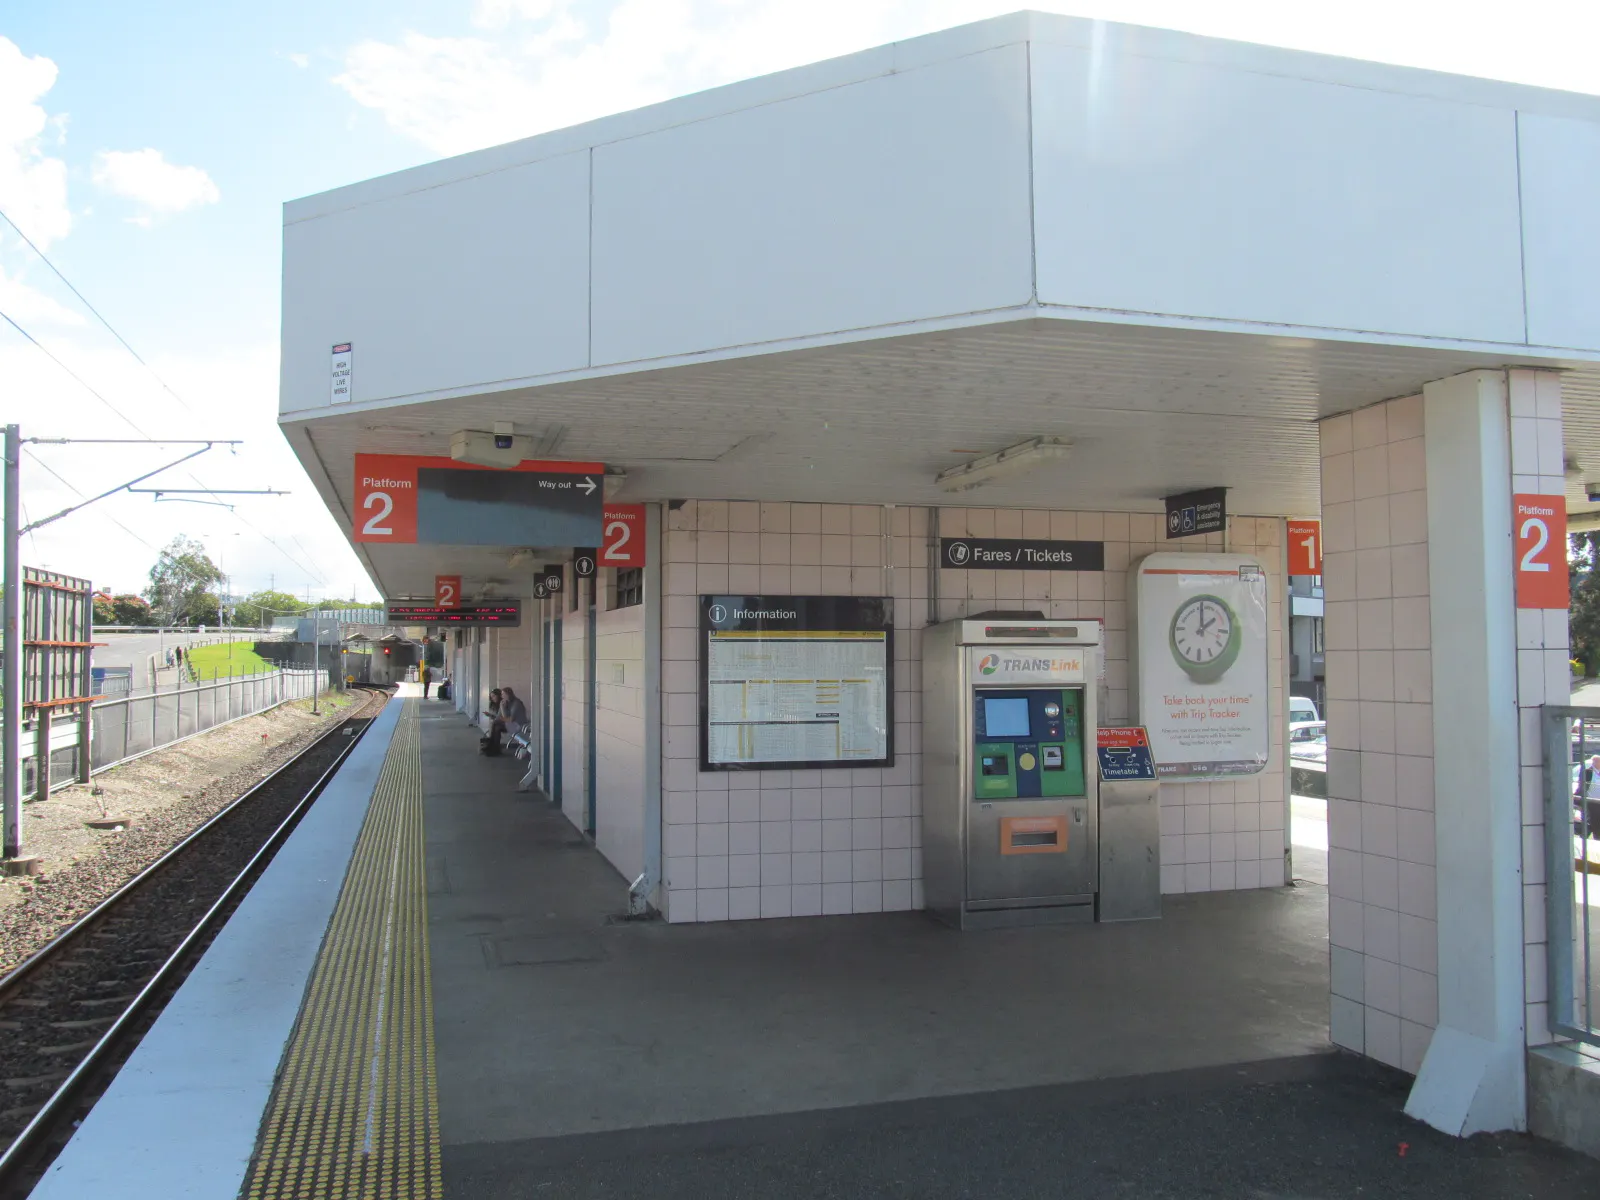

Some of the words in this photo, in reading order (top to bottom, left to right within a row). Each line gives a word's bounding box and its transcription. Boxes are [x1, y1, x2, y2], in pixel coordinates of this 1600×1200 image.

[363, 477, 412, 489] Platform
[538, 480, 556, 490] Way
[558, 481, 572, 489] out
[362, 491, 393, 535] 2
[1196, 503, 1220, 512] Emergency
[1518, 504, 1554, 516] Platform
[604, 512, 636, 520] Platform
[1201, 511, 1220, 519] disability
[1196, 521, 1220, 529] assistance
[604, 521, 631, 560] 2
[1520, 517, 1550, 572] 2
[973, 548, 1012, 562] Fares
[1024, 548, 1073, 562] Tickets
[1300, 535, 1316, 569] 1
[439, 585, 455, 606] 2
[733, 608, 797, 619] Information
[1003, 659, 1080, 672] TRANSLink
[1163, 695, 1183, 706] Take
[1185, 694, 1205, 705] back
[1208, 696, 1227, 707] your
[1170, 709, 1189, 719] with
[1190, 708, 1207, 721] Trip
